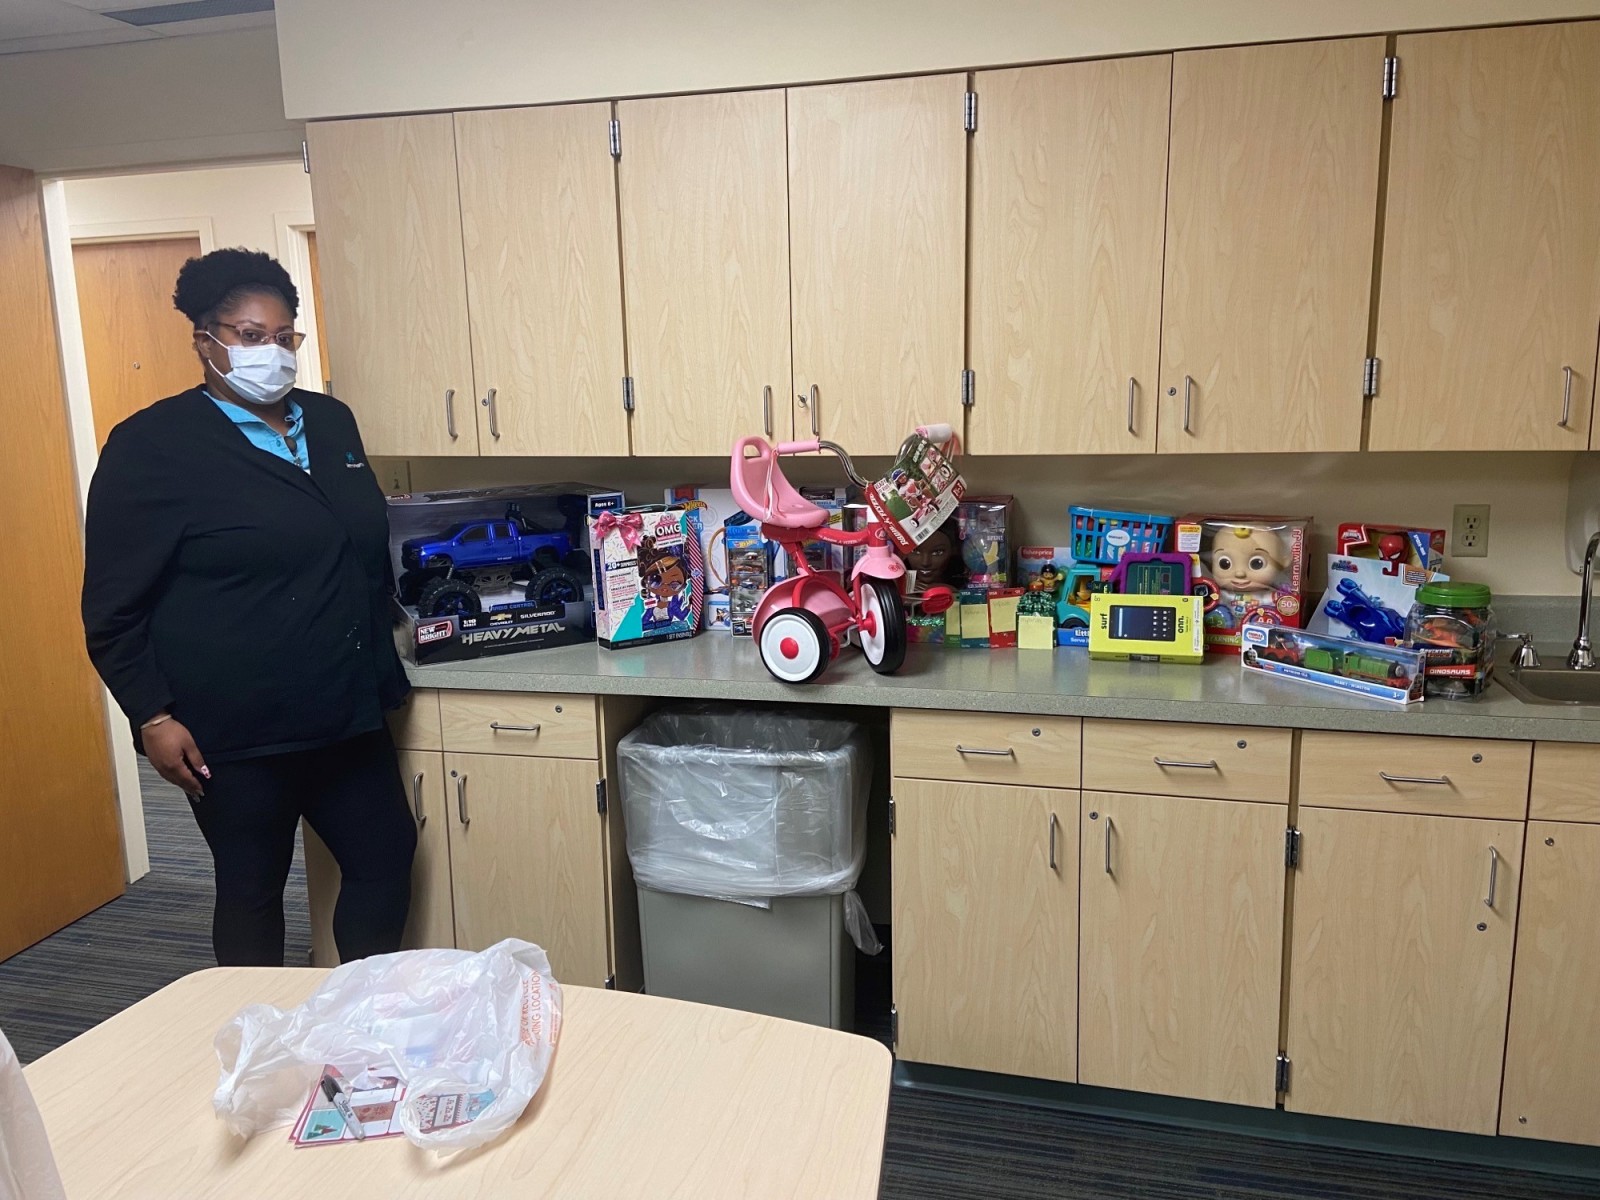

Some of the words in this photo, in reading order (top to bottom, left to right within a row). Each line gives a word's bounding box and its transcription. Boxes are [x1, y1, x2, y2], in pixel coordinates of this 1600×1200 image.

[656, 523, 681, 536] OMG
[1292, 529, 1302, 541] JJ
[1292, 541, 1302, 565] with
[607, 561, 621, 571] 20+
[1292, 565, 1301, 592] Learn
[1280, 600, 1297, 608] 50+
[520, 610, 556, 619] SILVERADO
[1100, 613, 1108, 630] surf
[420, 625, 436, 635] NEW
[420, 630, 448, 641] BRIGHT
[461, 628, 514, 645] HEAVY
[510, 622, 566, 639] METAL
[1429, 668, 1471, 676] DINOSAURS
